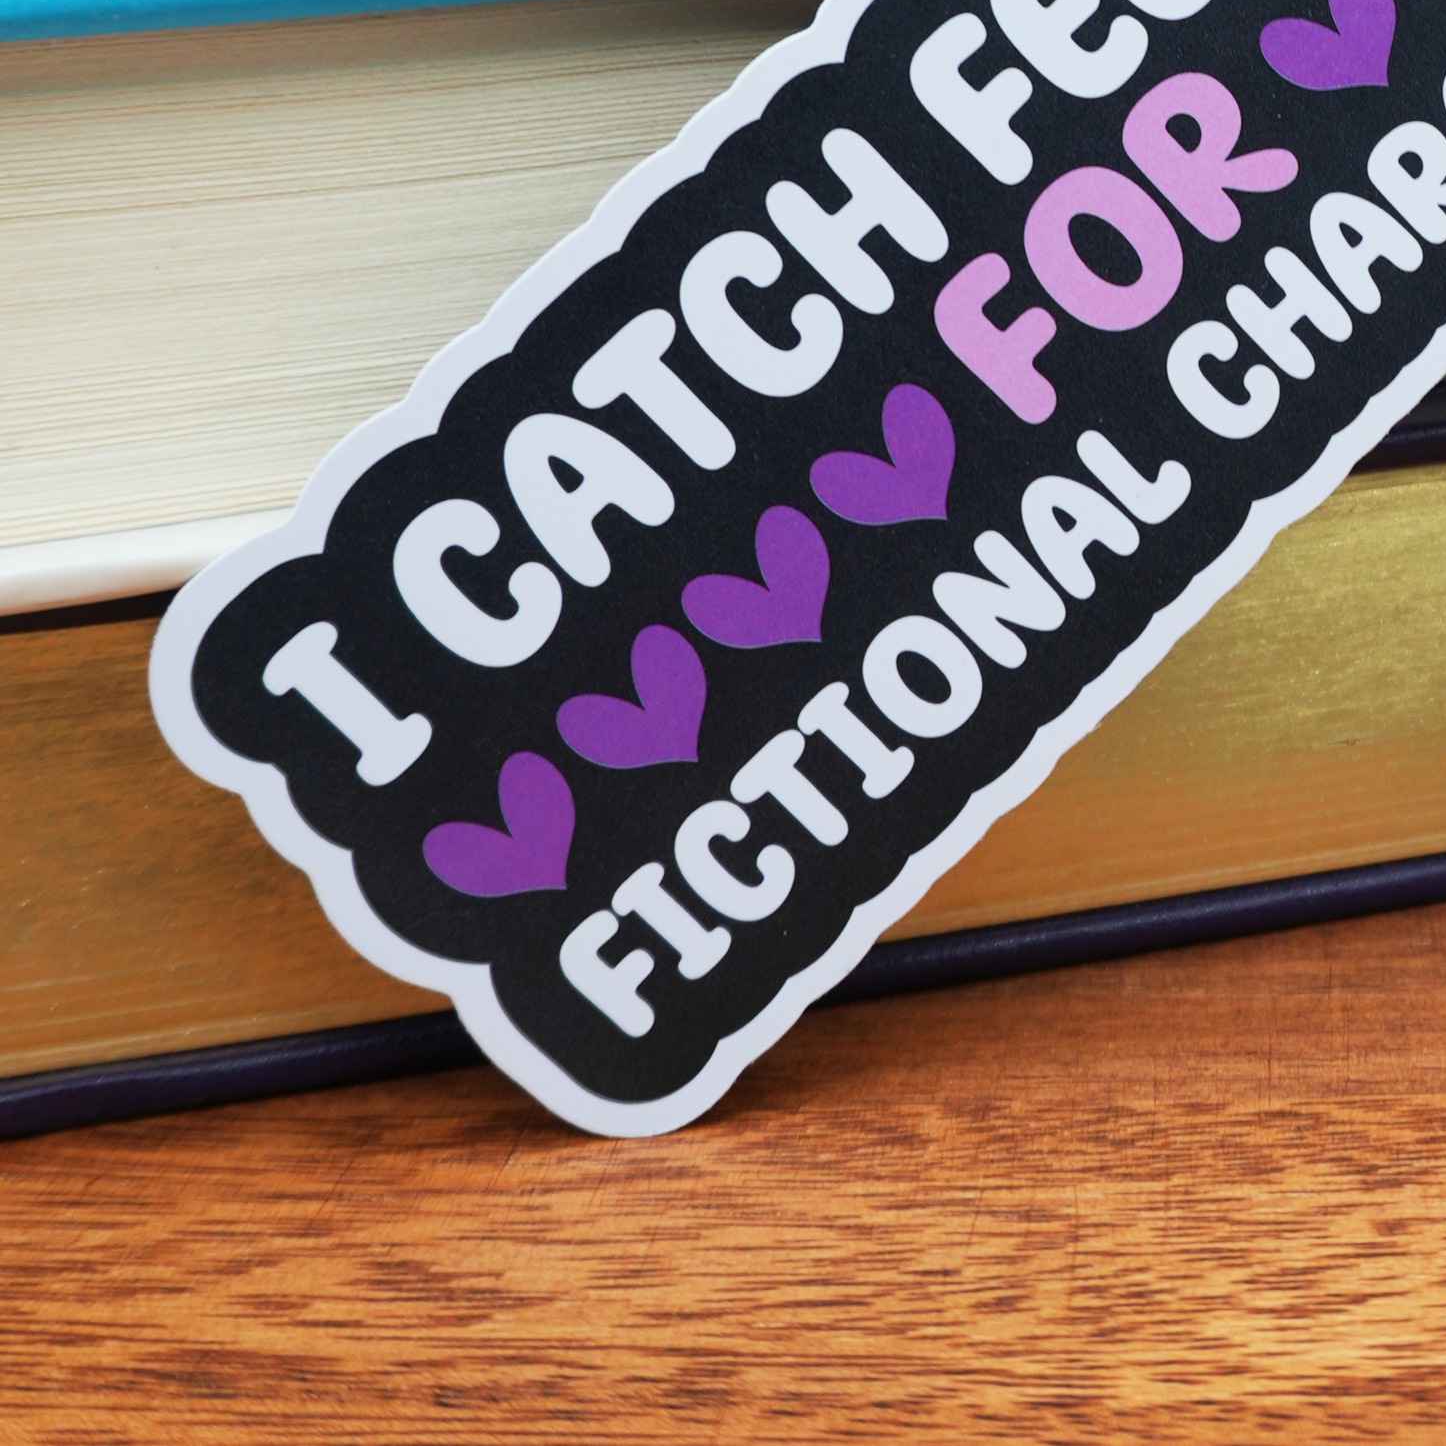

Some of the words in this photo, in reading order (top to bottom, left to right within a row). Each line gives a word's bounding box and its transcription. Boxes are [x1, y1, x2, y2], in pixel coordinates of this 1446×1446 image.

[263, 622, 432, 785] I
[394, 129, 948, 667] CATCH
[935, 73, 1298, 423] FOR
[560, 431, 1191, 1037] FICTIONAL
